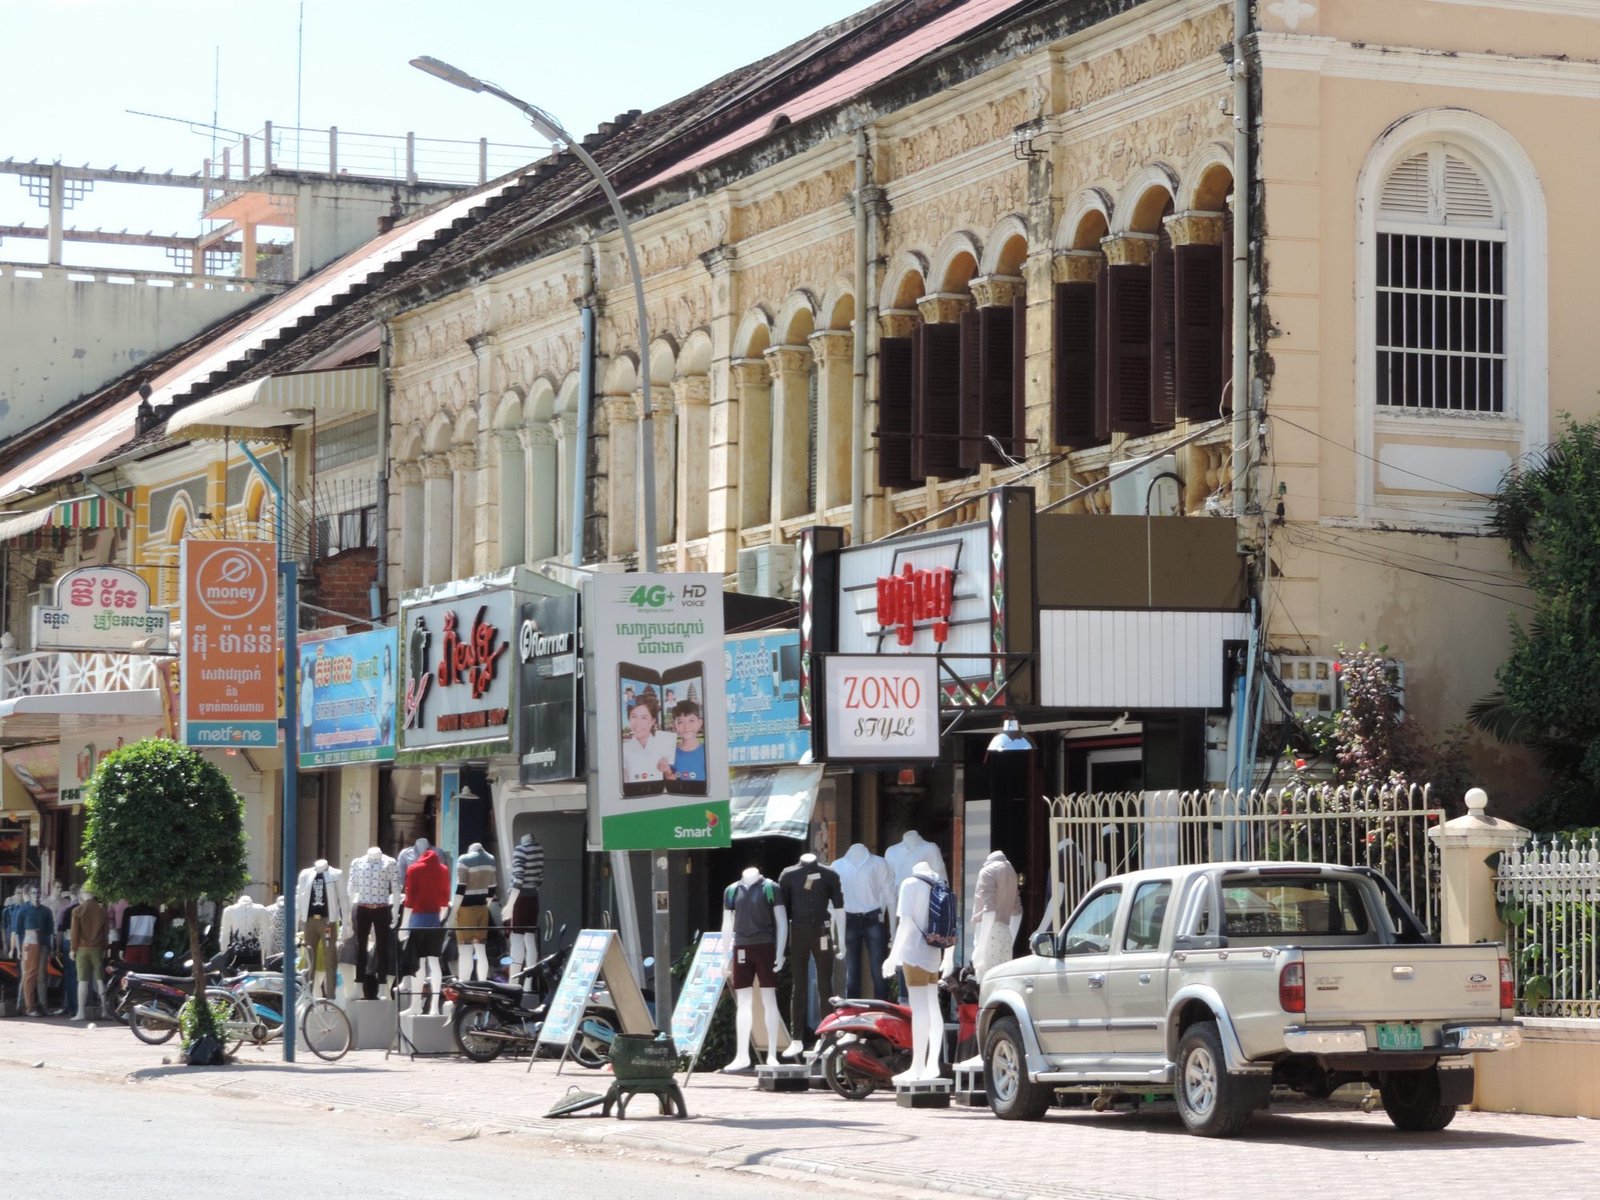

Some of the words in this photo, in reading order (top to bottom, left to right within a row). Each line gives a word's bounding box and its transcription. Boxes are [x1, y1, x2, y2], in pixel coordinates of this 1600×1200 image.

[207, 587, 256, 602] money
[682, 584, 707, 598] HD
[531, 632, 568, 657] flormar
[844, 676, 920, 709] ZONO
[198, 726, 262, 742] metfone
[854, 716, 915, 741] STYLE
[674, 826, 713, 838] Smart
